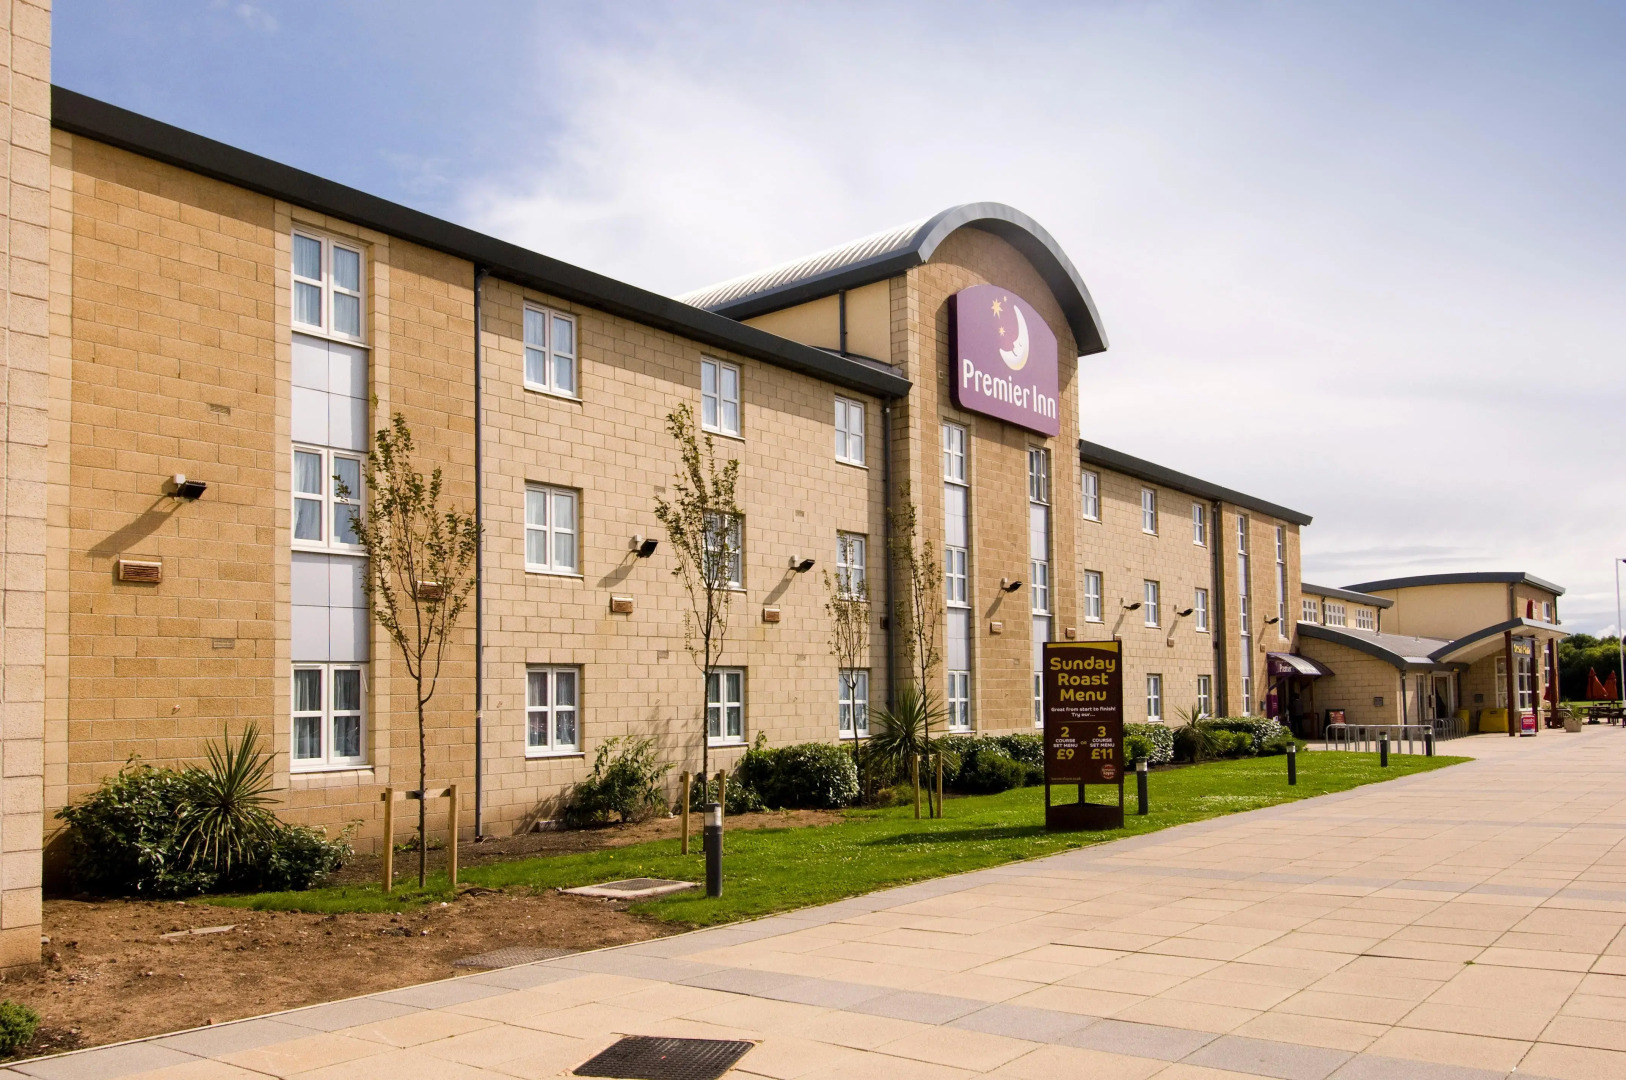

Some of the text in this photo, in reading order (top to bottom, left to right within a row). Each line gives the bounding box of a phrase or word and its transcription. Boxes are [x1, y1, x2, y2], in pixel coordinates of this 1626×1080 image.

[963, 358, 1056, 419] Premier Inn
[1050, 656, 1116, 672] Sunday
[1058, 673, 1109, 686] Roast
[1060, 689, 1107, 701] Menu
[1061, 726, 1069, 738] 2
[1097, 725, 1106, 737] 3
[1056, 748, 1075, 760] £9
[1091, 748, 1113, 760] £11
